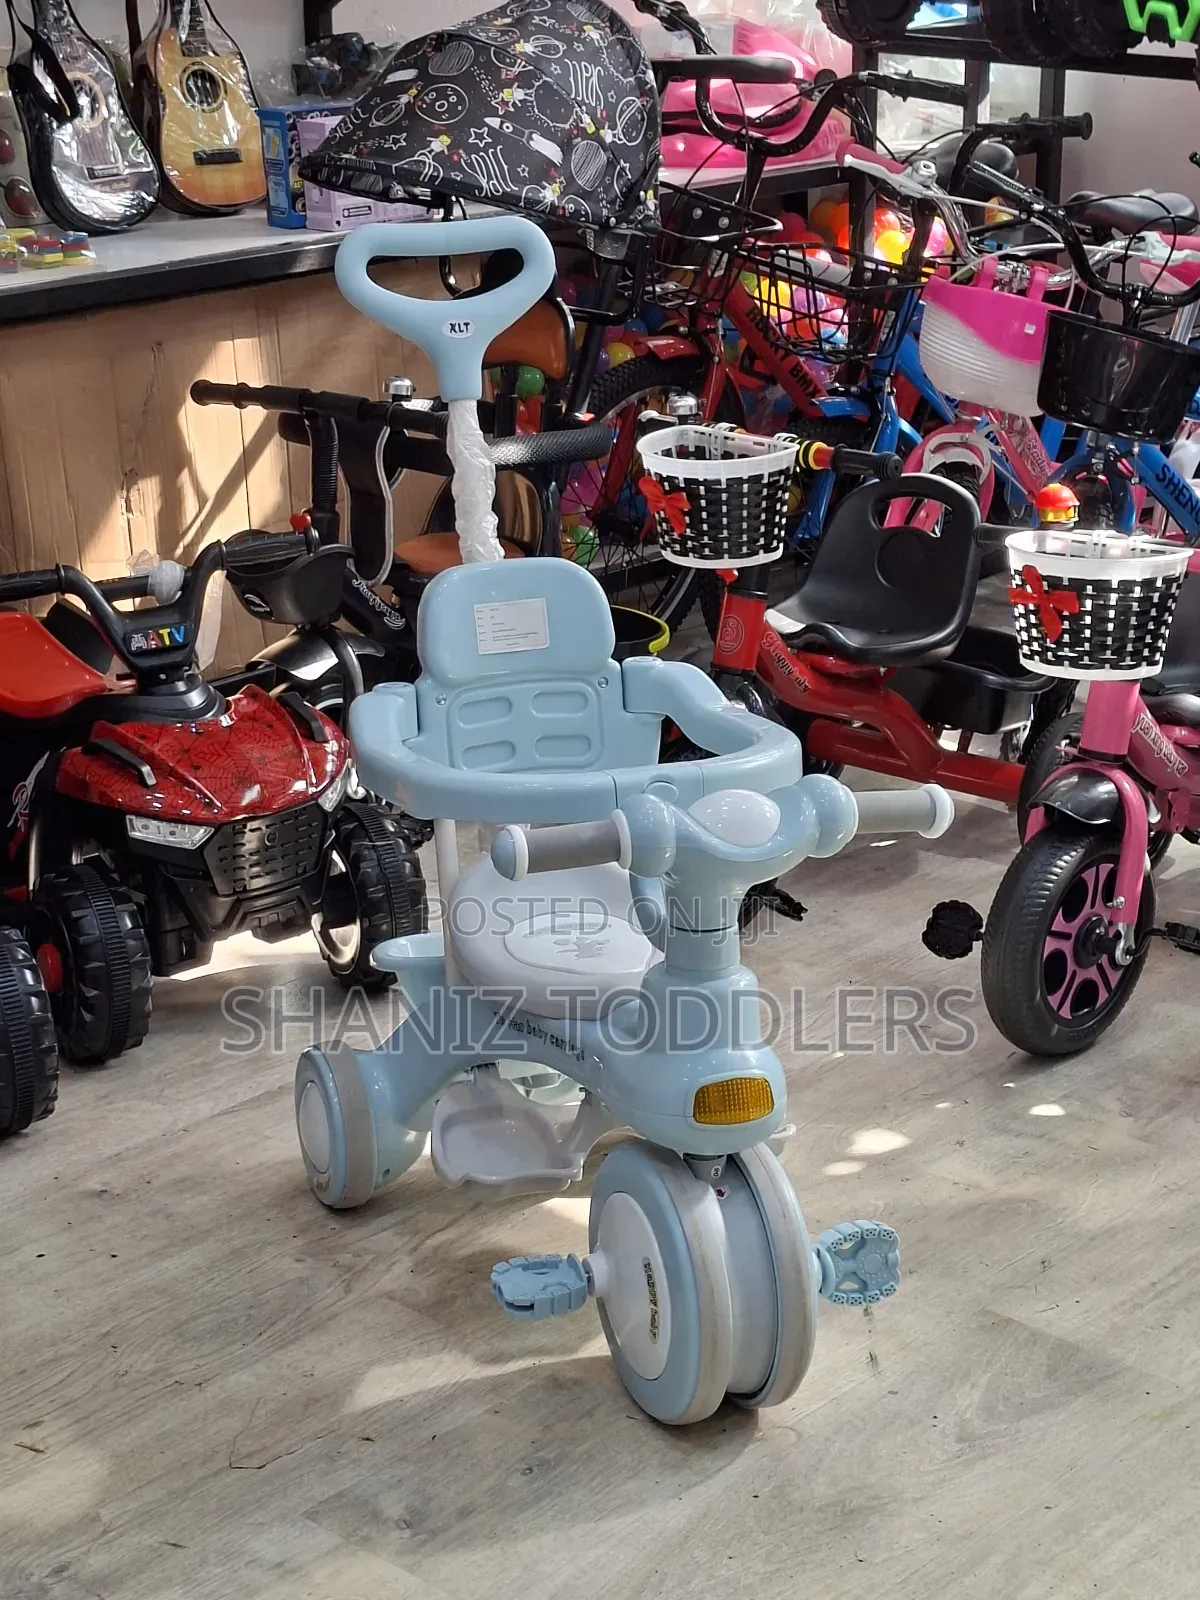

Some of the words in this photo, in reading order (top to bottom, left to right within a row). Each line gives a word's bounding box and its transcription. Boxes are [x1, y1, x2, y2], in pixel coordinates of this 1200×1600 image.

[449, 322, 470, 334] XLT
[788, 361, 822, 400] BMX
[148, 625, 185, 649] ATV
